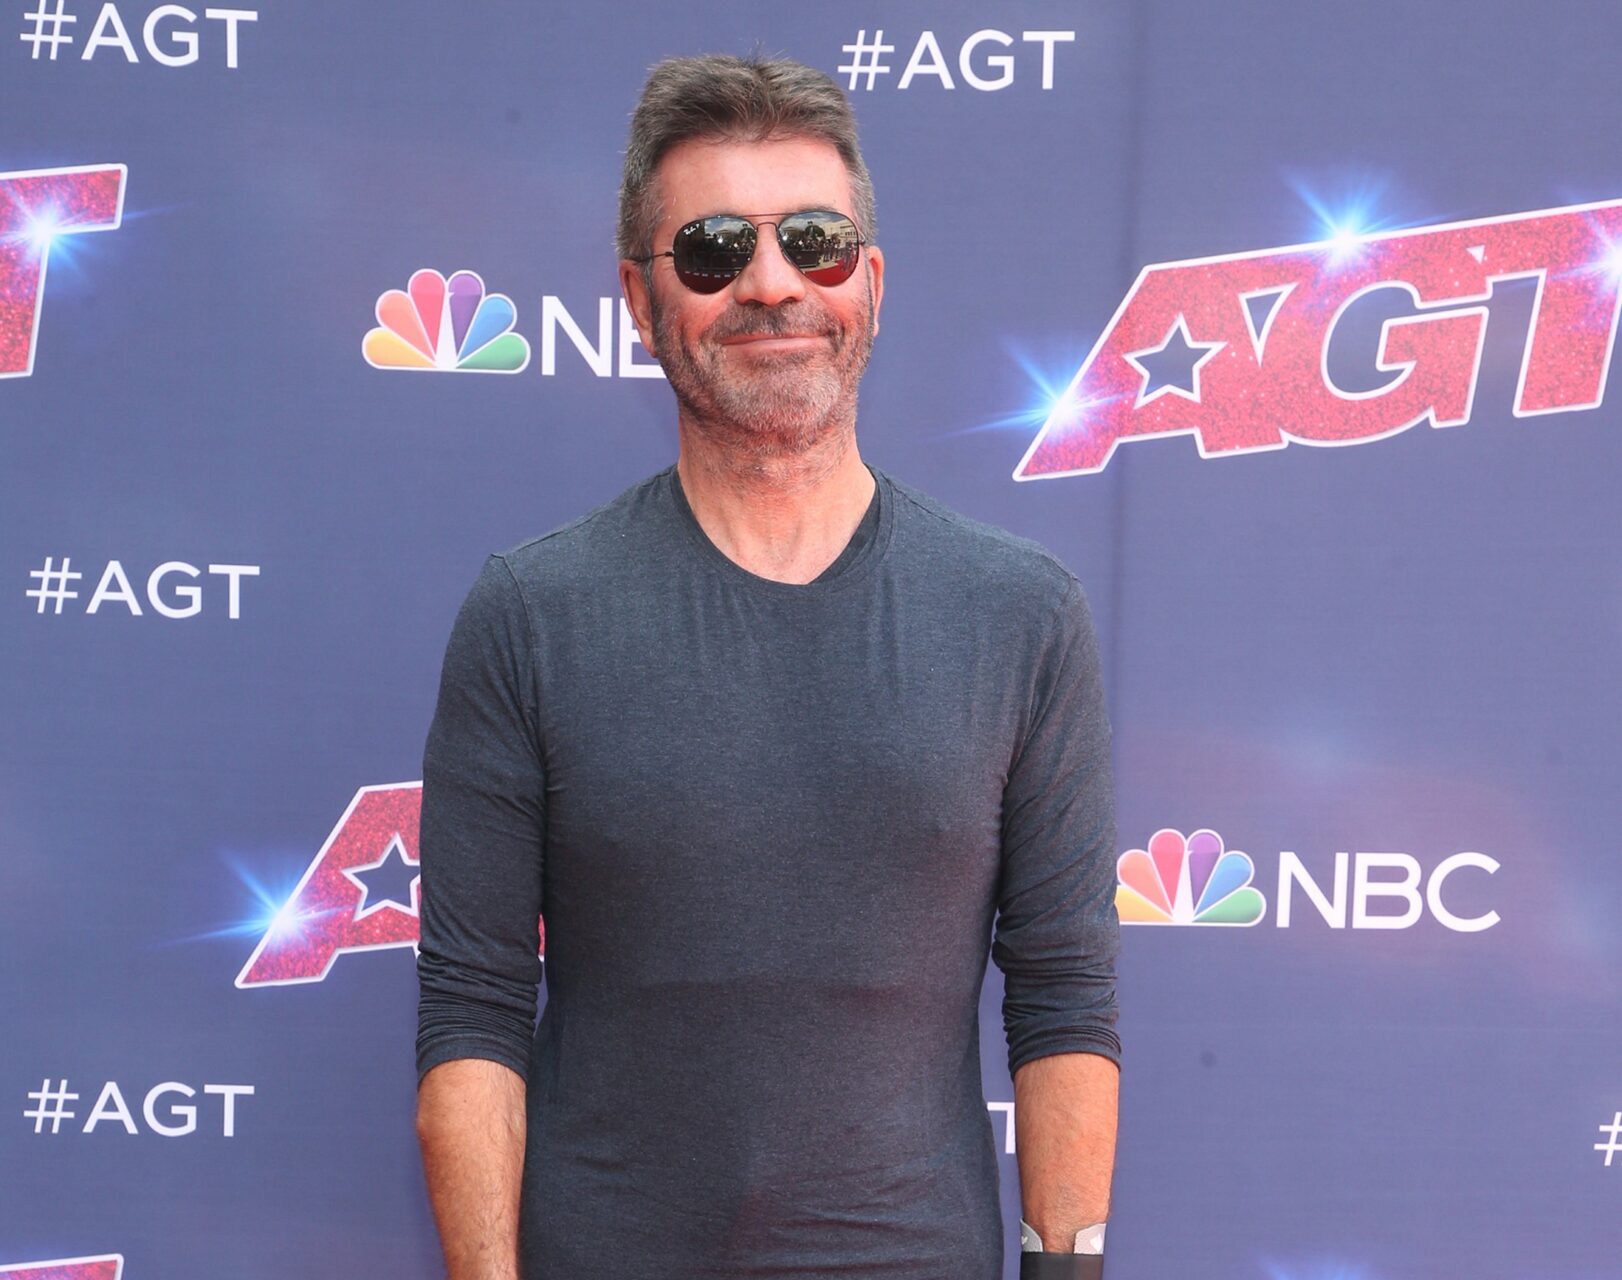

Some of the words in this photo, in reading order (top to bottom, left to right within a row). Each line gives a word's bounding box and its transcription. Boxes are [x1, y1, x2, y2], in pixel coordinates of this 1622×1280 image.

[20, 0, 258, 69] #AGT
[837, 29, 1075, 91] #AGT
[1012, 198, 1622, 482] AGT
[26, 557, 260, 619] #AGT
[1276, 851, 1501, 932] NBC
[24, 1079, 255, 1138] #AGT
